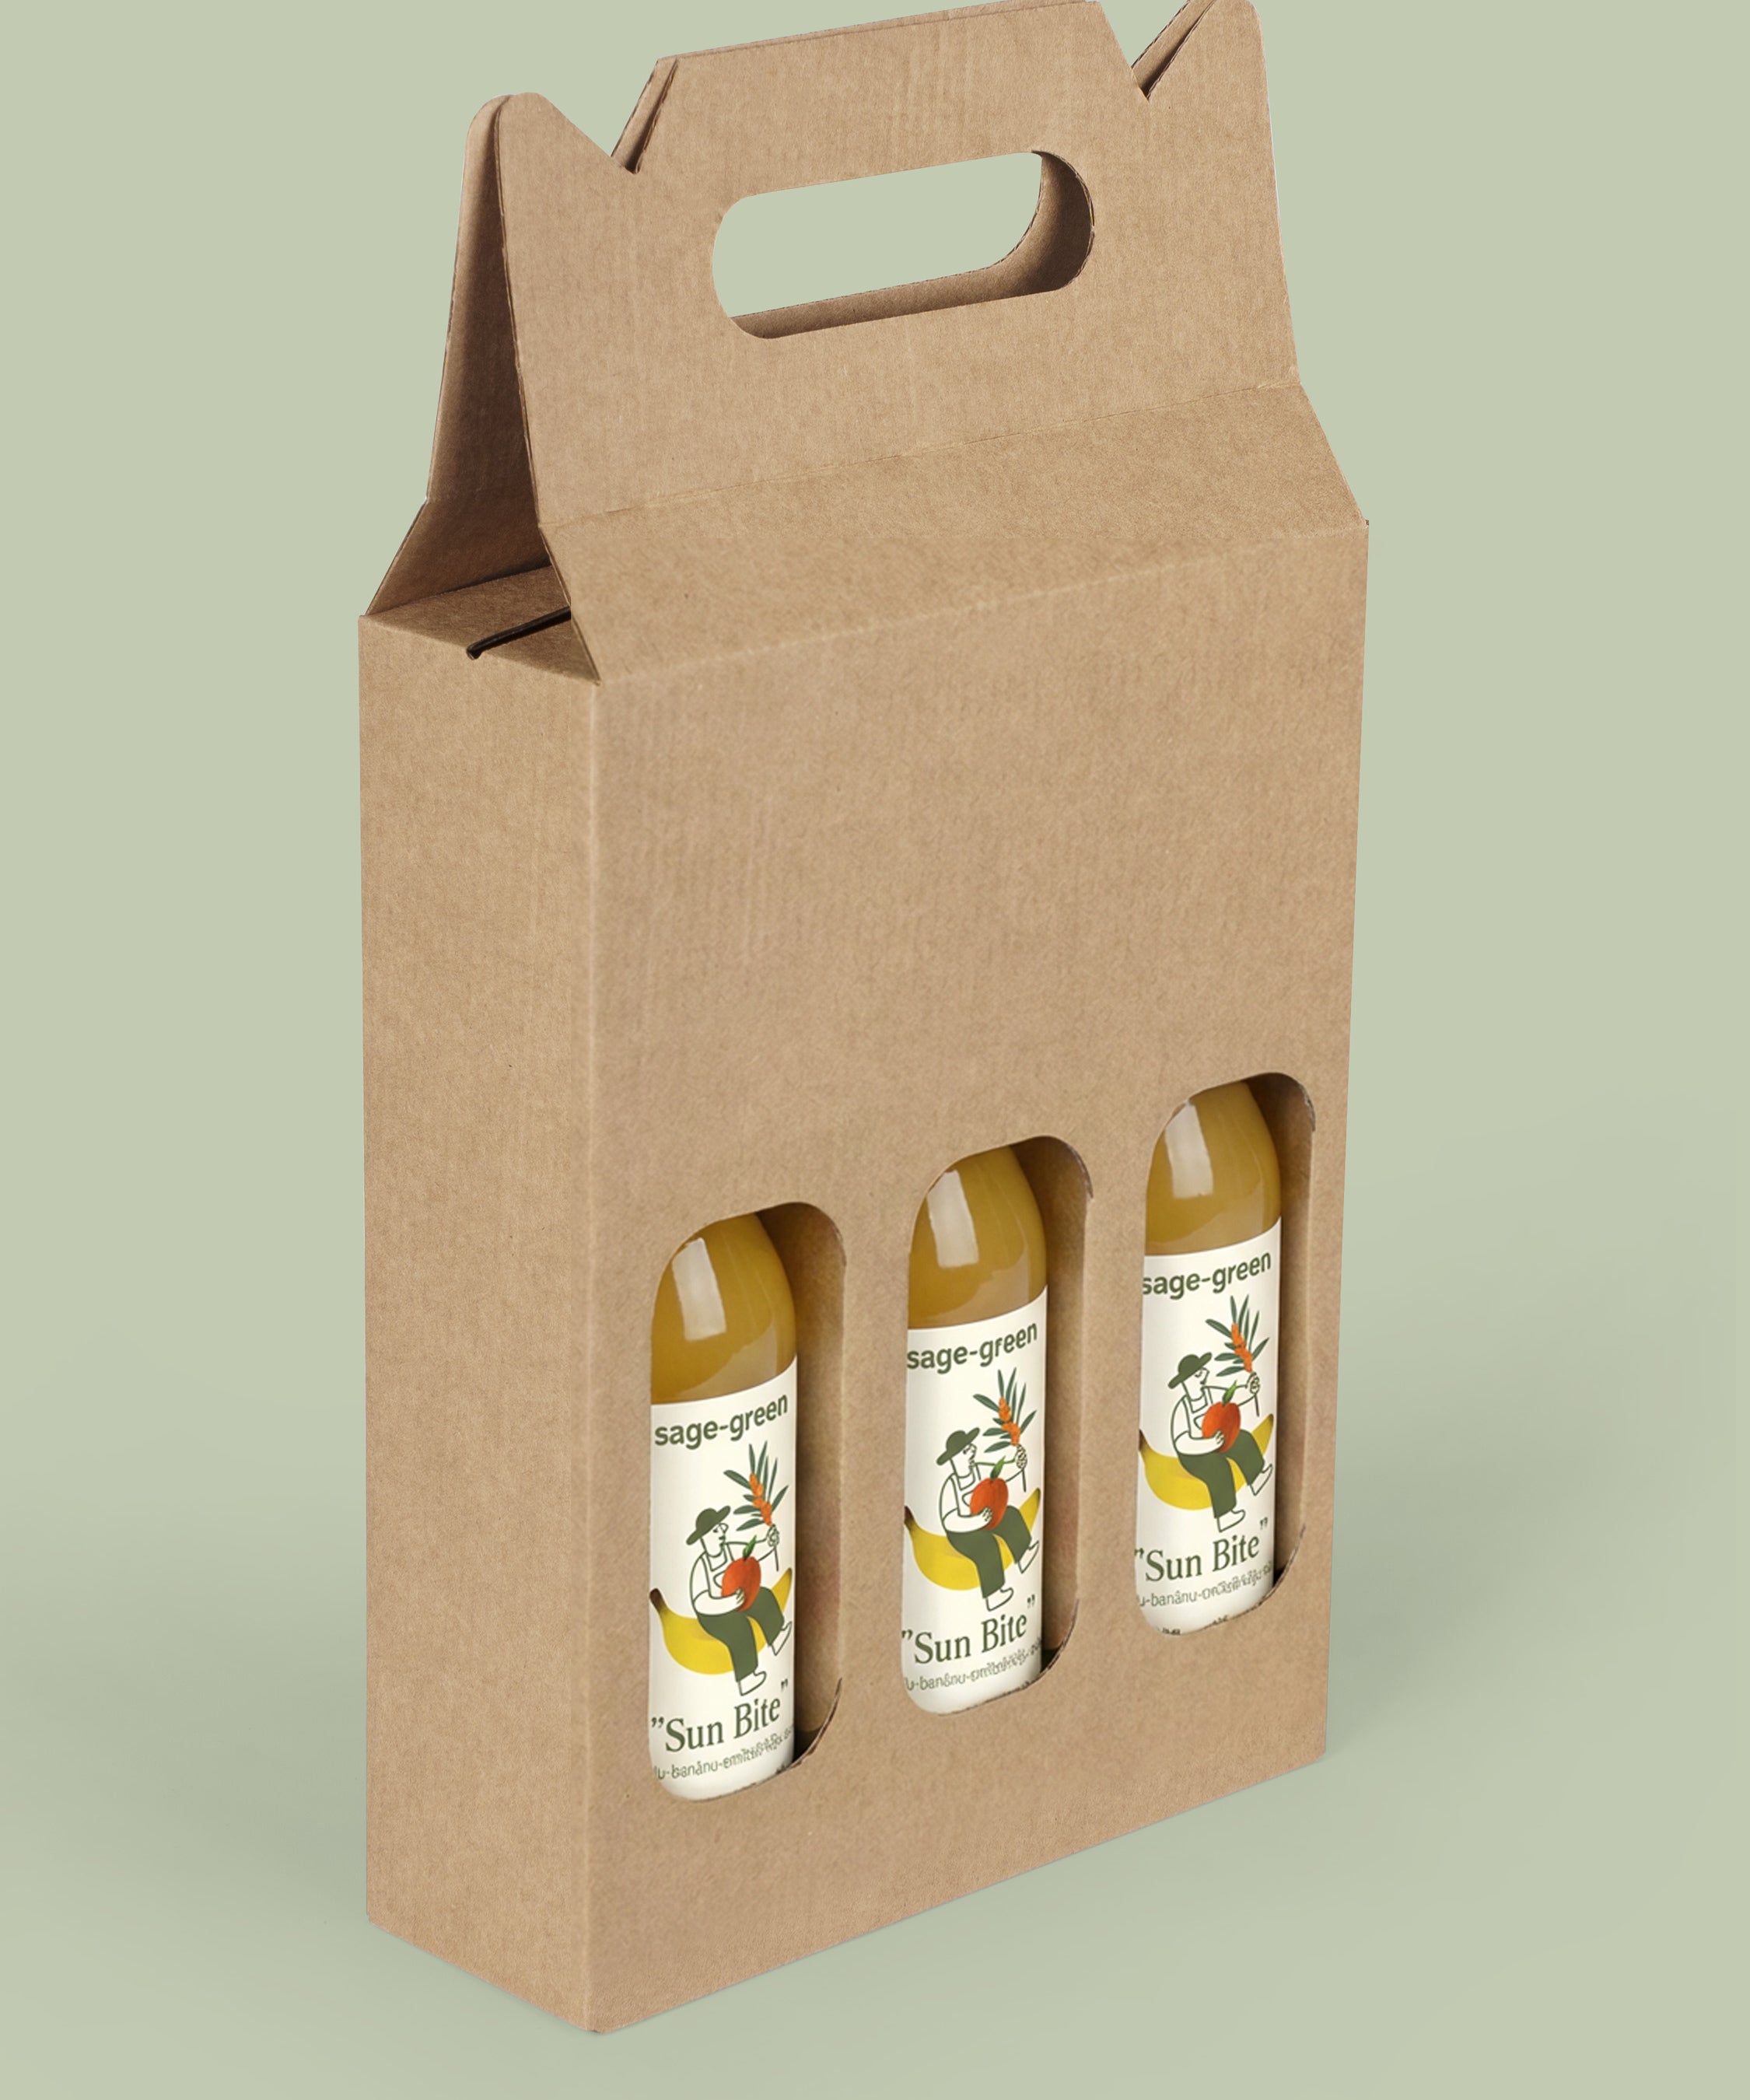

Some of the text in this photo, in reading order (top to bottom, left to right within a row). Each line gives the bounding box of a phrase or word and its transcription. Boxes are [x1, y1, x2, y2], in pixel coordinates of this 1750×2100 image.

[1143, 1252, 1271, 1300] sage-green
[907, 1323, 1038, 1374] sage-green
[654, 1395, 788, 1450] sage-green
